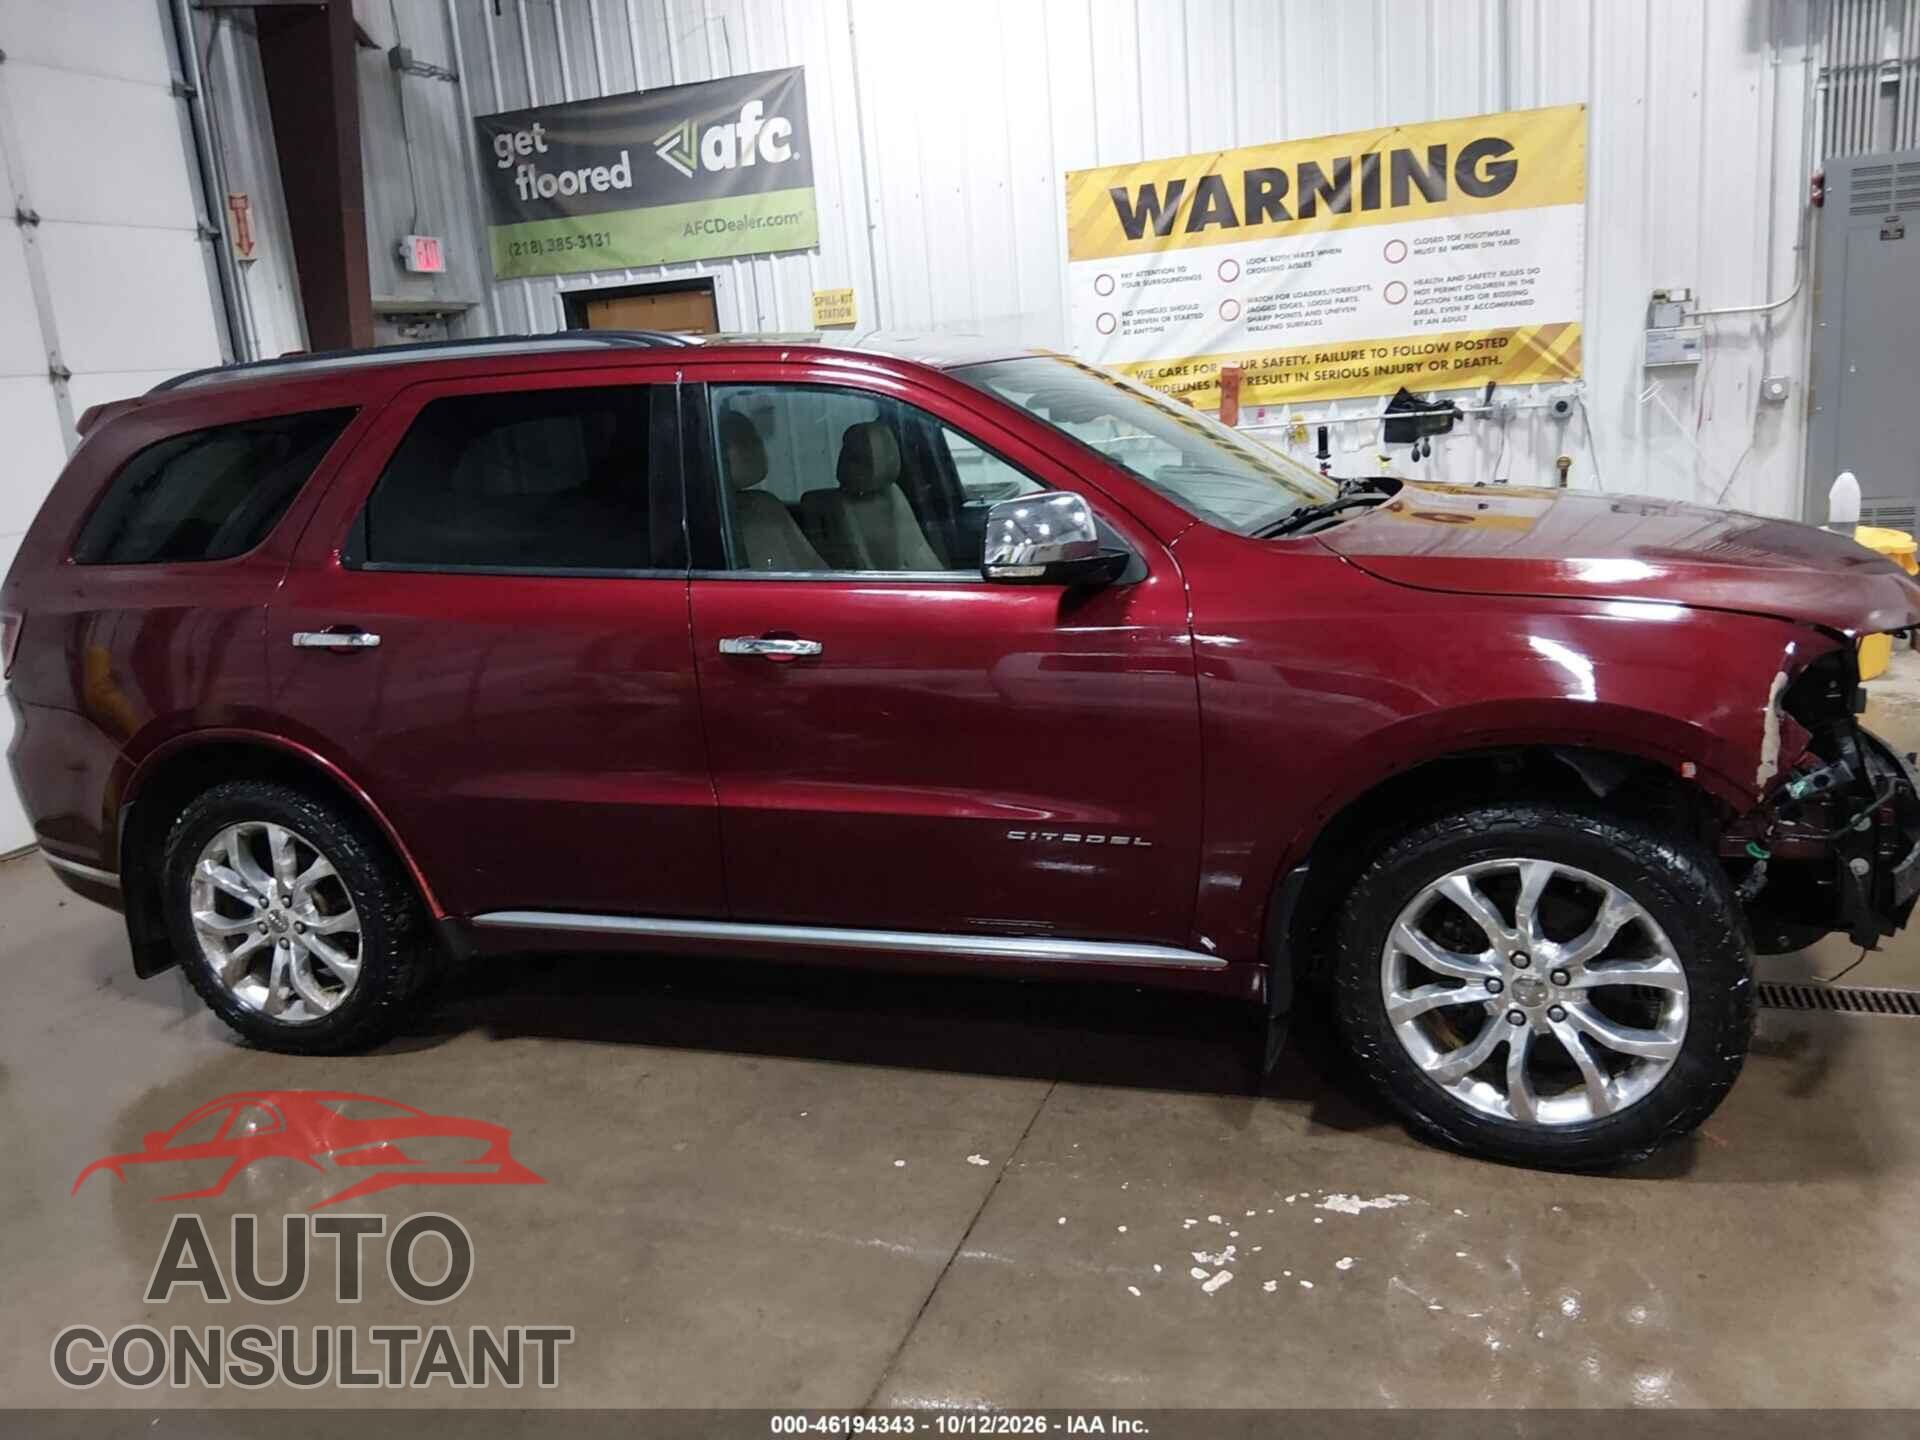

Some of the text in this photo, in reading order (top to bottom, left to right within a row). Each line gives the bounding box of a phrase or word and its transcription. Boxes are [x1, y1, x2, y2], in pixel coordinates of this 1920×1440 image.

[494, 122, 548, 168] get
[515, 150, 632, 200] floored
[1109, 136, 1519, 241] WARNING
[682, 213, 799, 237] AFCDealer.com
[1464, 229, 1511, 239] FOOTWEAR
[509, 240, 543, 256] (218)
[1413, 246, 1436, 255] MUST
[1451, 243, 1478, 251] WORN
[1136, 268, 1175, 277] ATTENTION
[1446, 275, 1465, 283] AND
[1467, 271, 1497, 280] SAFETY
[1433, 285, 1462, 294] PERMIT
[1464, 281, 1505, 291] CHILDREN
[1174, 312, 1204, 321] STARTED
[1136, 368, 1153, 379] WE
[1158, 365, 1189, 377] CARE
[1193, 363, 1216, 375] FOR
[1263, 354, 1310, 369] SAFETY.
[1315, 349, 1366, 364] FAILURE
[1371, 347, 1387, 359] TO
[1393, 342, 1450, 357] FOLLOW
[1455, 337, 1509, 350] POSTED
[1149, 380, 1210, 394] UIDELINES
[1247, 374, 1289, 386] RESULT
[1295, 372, 1309, 382] IN
[1314, 367, 1370, 381] SERIOUS
[1374, 362, 1425, 376] INJURY
[1428, 360, 1449, 371] OR
[1454, 356, 1503, 369] DEATH.
[1007, 831, 1152, 846] CITADEL
